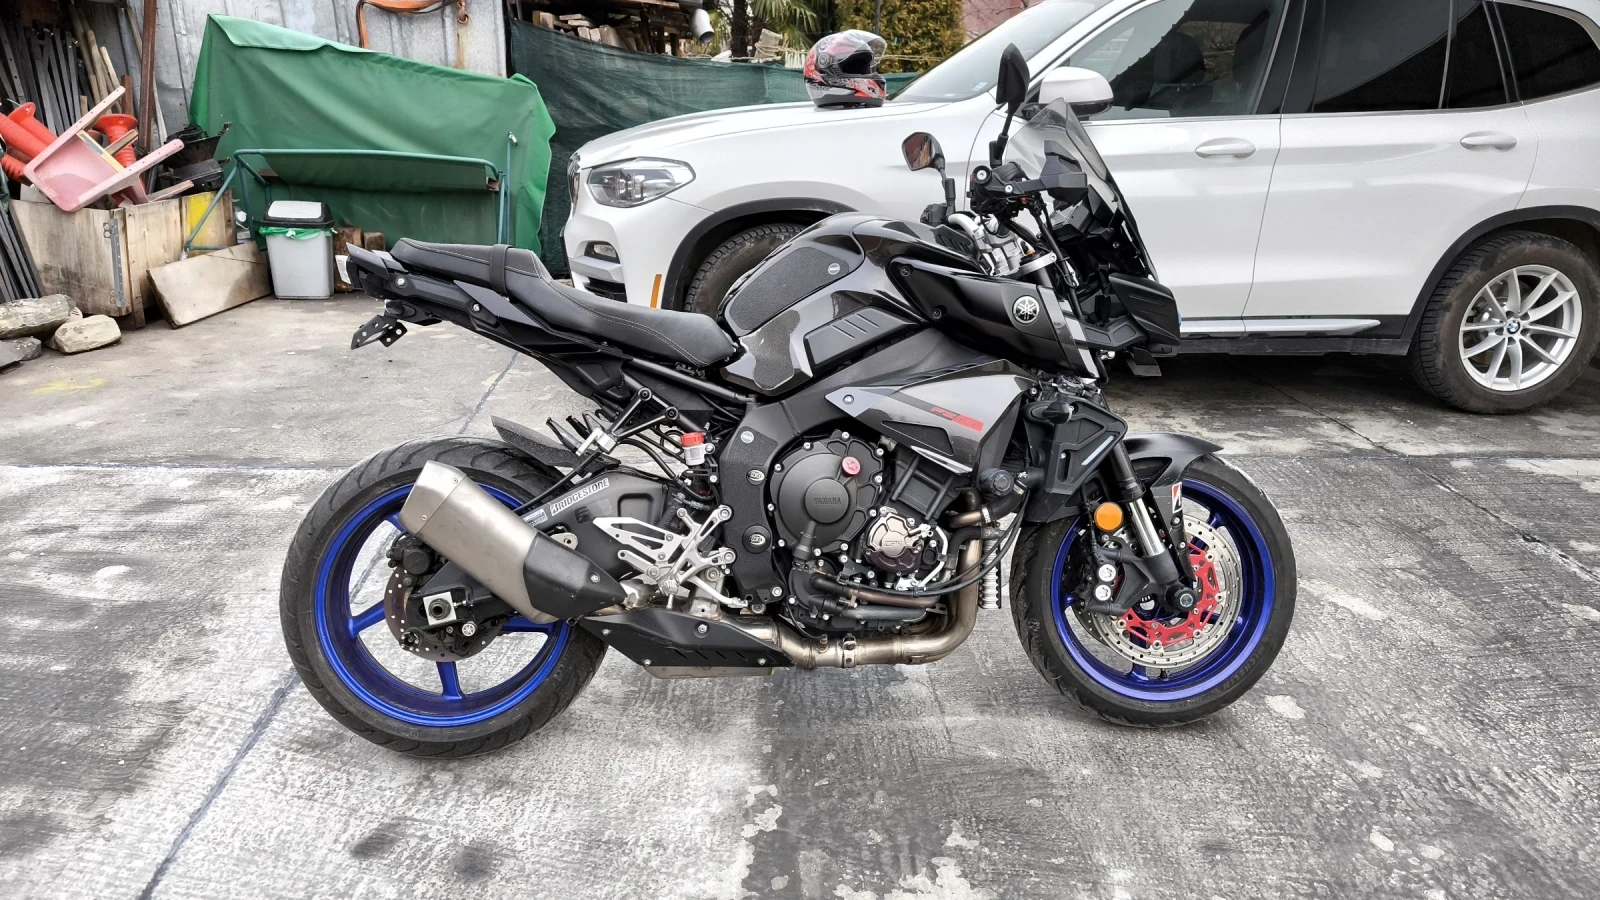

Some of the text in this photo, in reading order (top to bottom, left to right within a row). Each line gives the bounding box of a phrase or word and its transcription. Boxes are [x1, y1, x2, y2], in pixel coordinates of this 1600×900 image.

[551, 479, 608, 514] BRIDGESTONE
[813, 497, 841, 505] YAMAHA
[1223, 645, 1265, 690] MICHELIN
